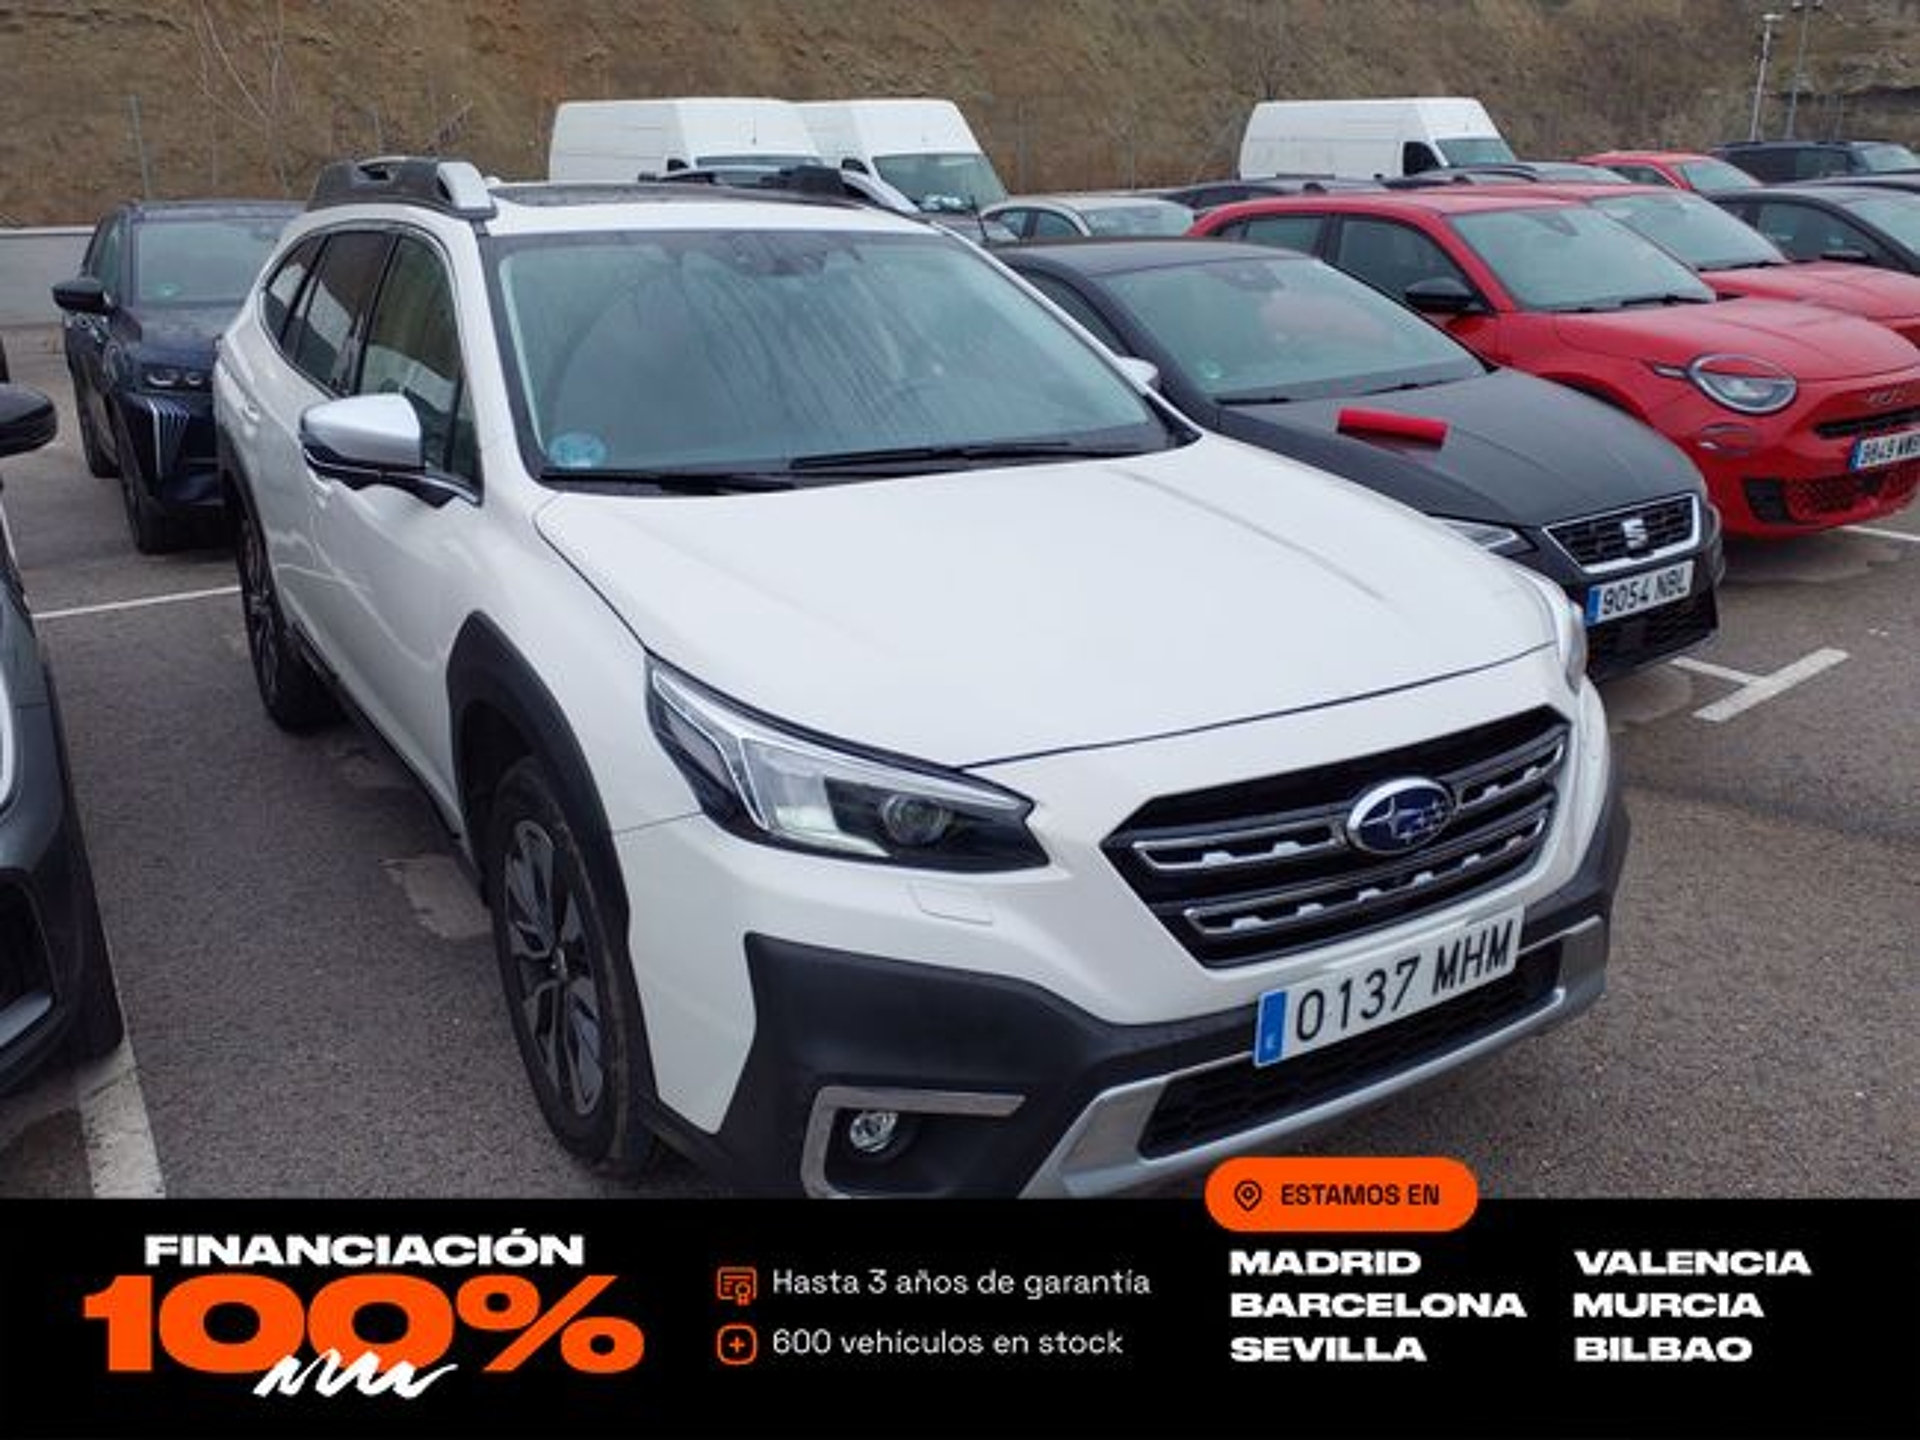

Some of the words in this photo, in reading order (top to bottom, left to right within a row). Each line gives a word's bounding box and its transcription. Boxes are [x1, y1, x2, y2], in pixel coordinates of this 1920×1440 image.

[1603, 577, 1650, 615] 9054
[1296, 956, 1421, 1042] 0137
[1432, 919, 1514, 996] MHM
